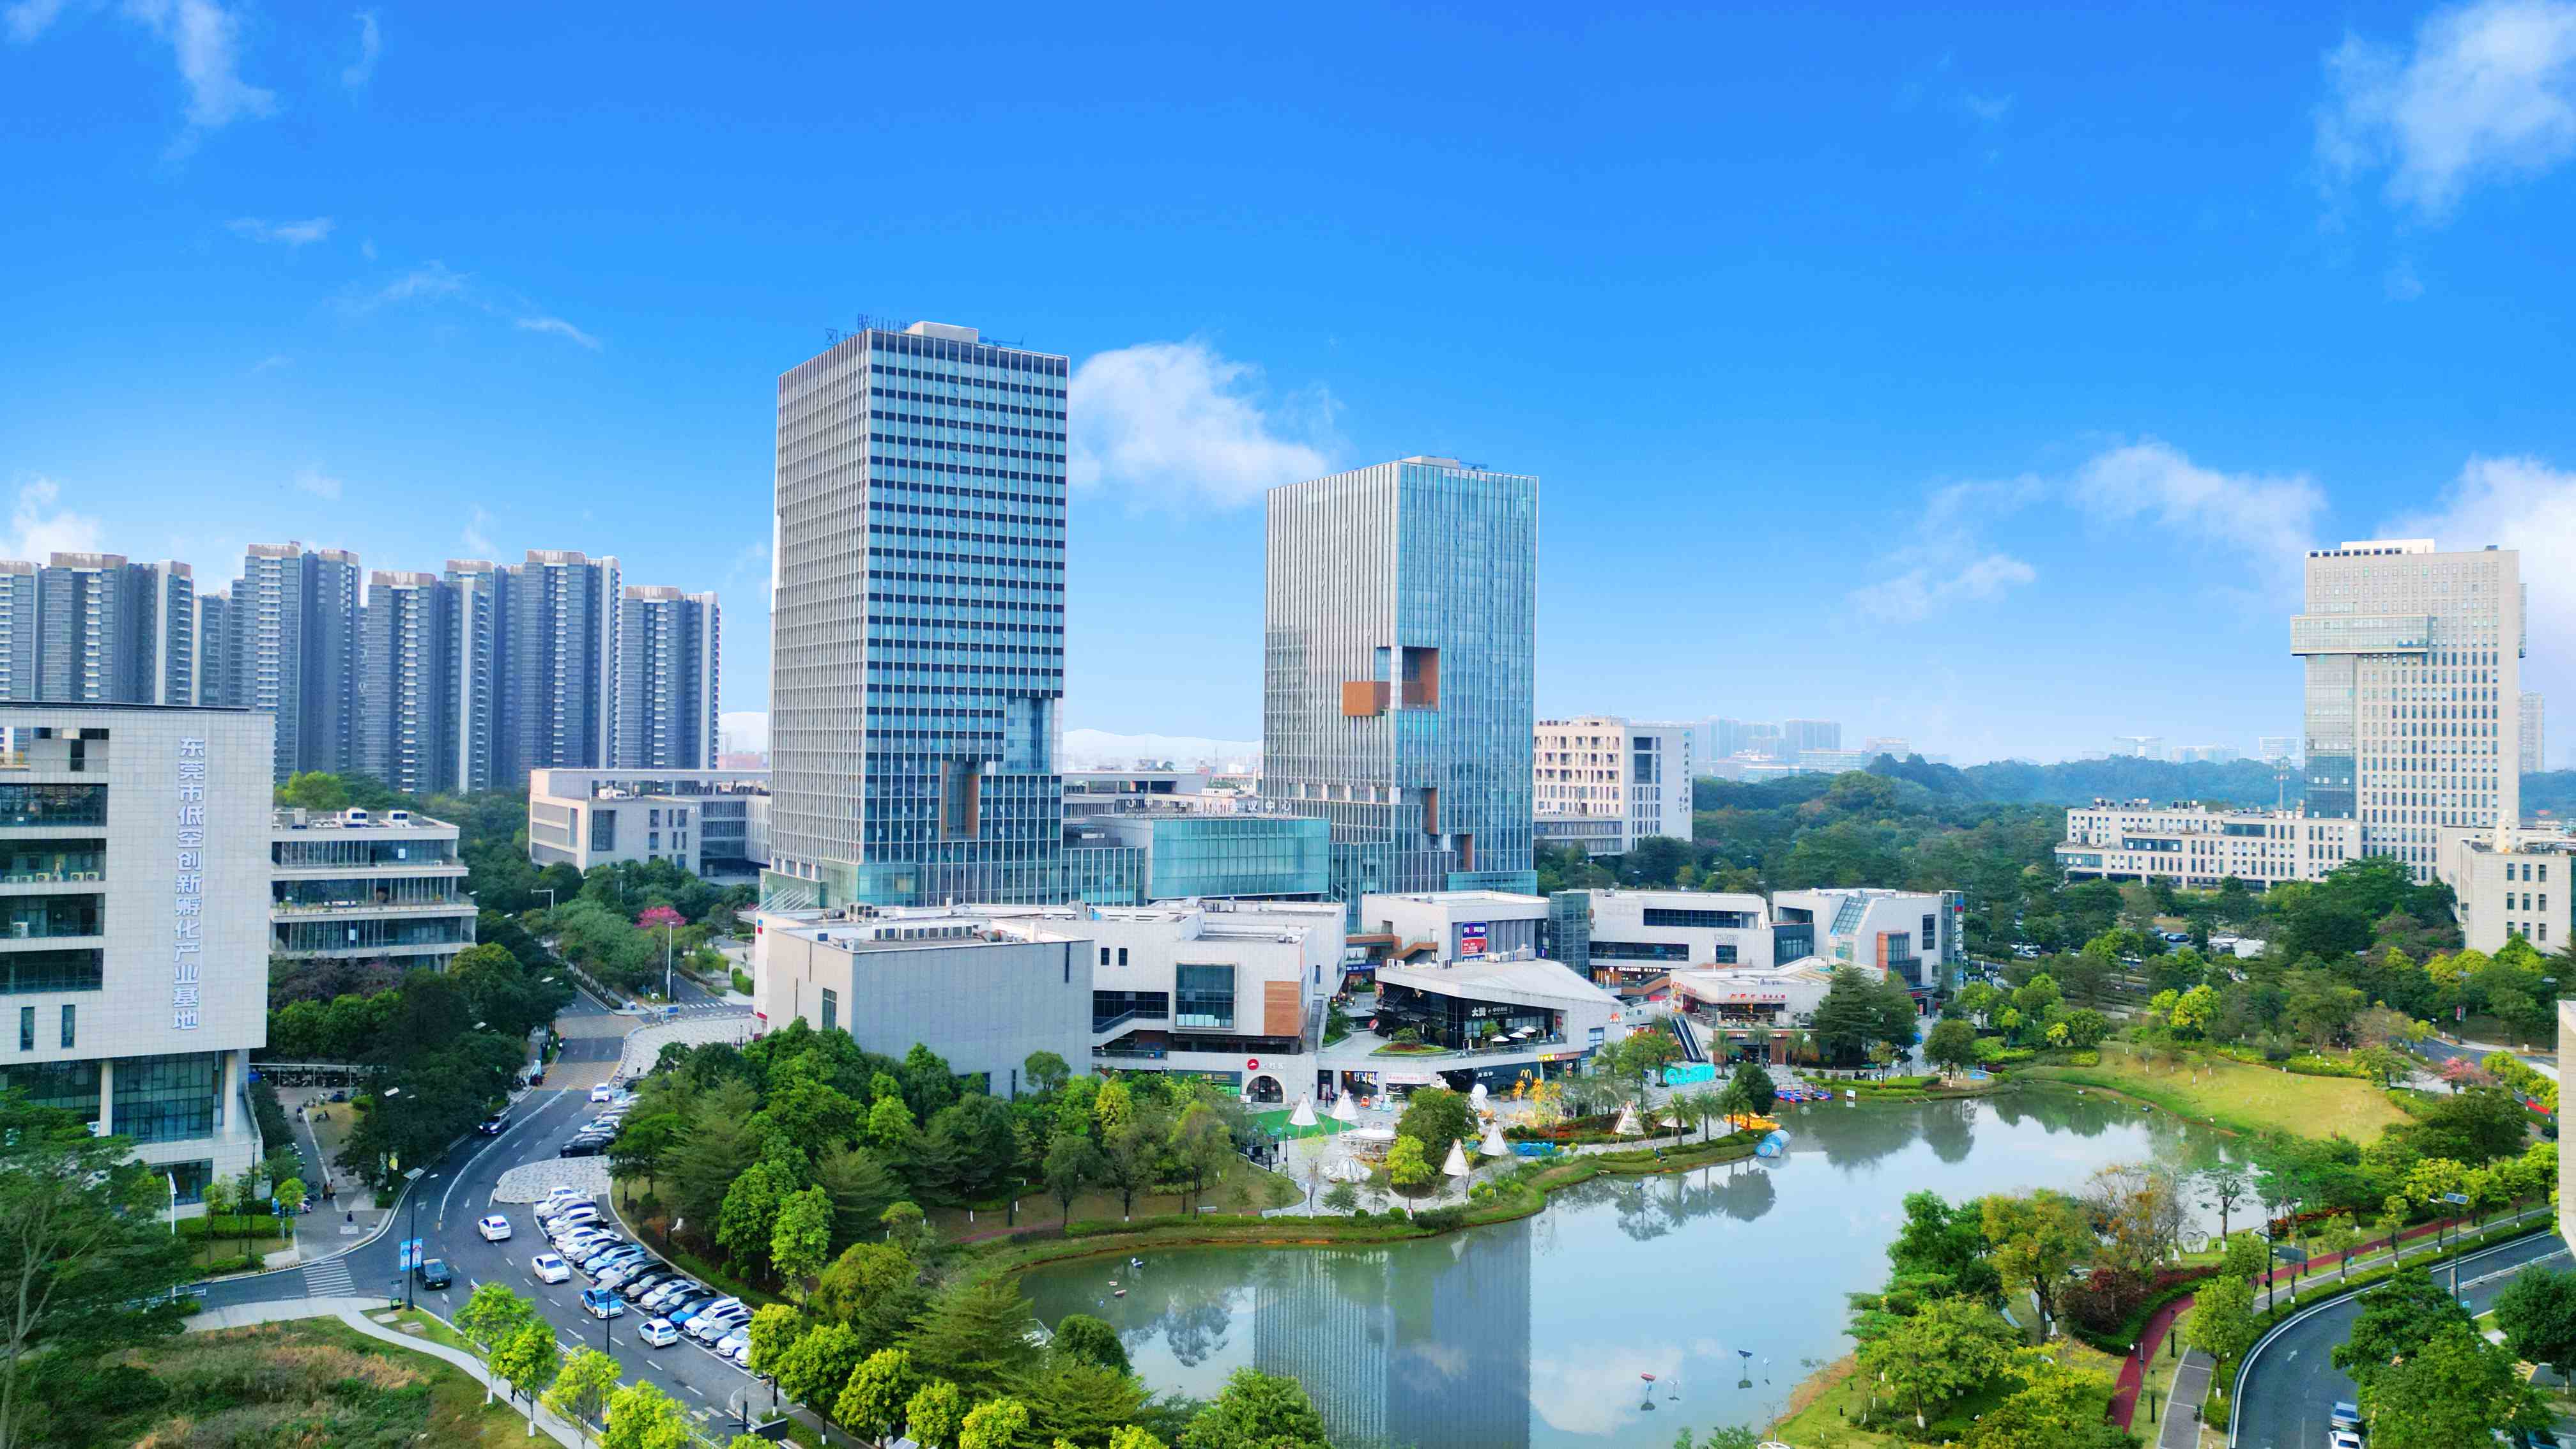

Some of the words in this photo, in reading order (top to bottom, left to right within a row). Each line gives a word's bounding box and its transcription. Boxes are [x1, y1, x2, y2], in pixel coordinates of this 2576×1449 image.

[171, 736, 206, 1031] 东莞市低空创新孵化产业基地
